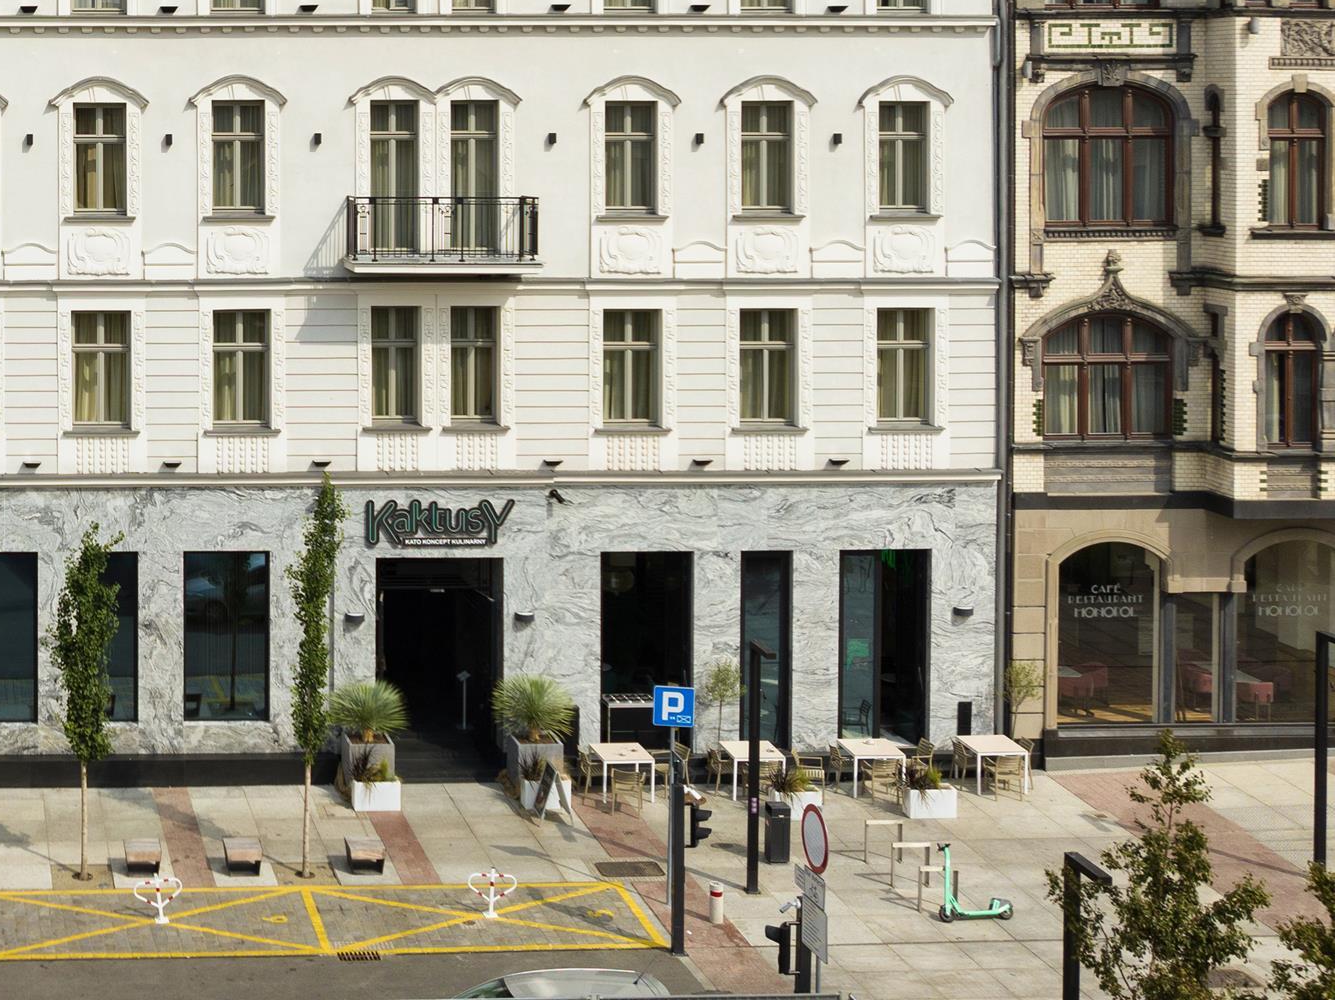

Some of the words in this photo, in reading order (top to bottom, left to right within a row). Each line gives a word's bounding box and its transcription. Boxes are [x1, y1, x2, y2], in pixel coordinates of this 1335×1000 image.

[1067, 594, 1144, 604] RESTAURANT
[1073, 606, 1137, 618] MONOPOL
[661, 691, 685, 721] P
